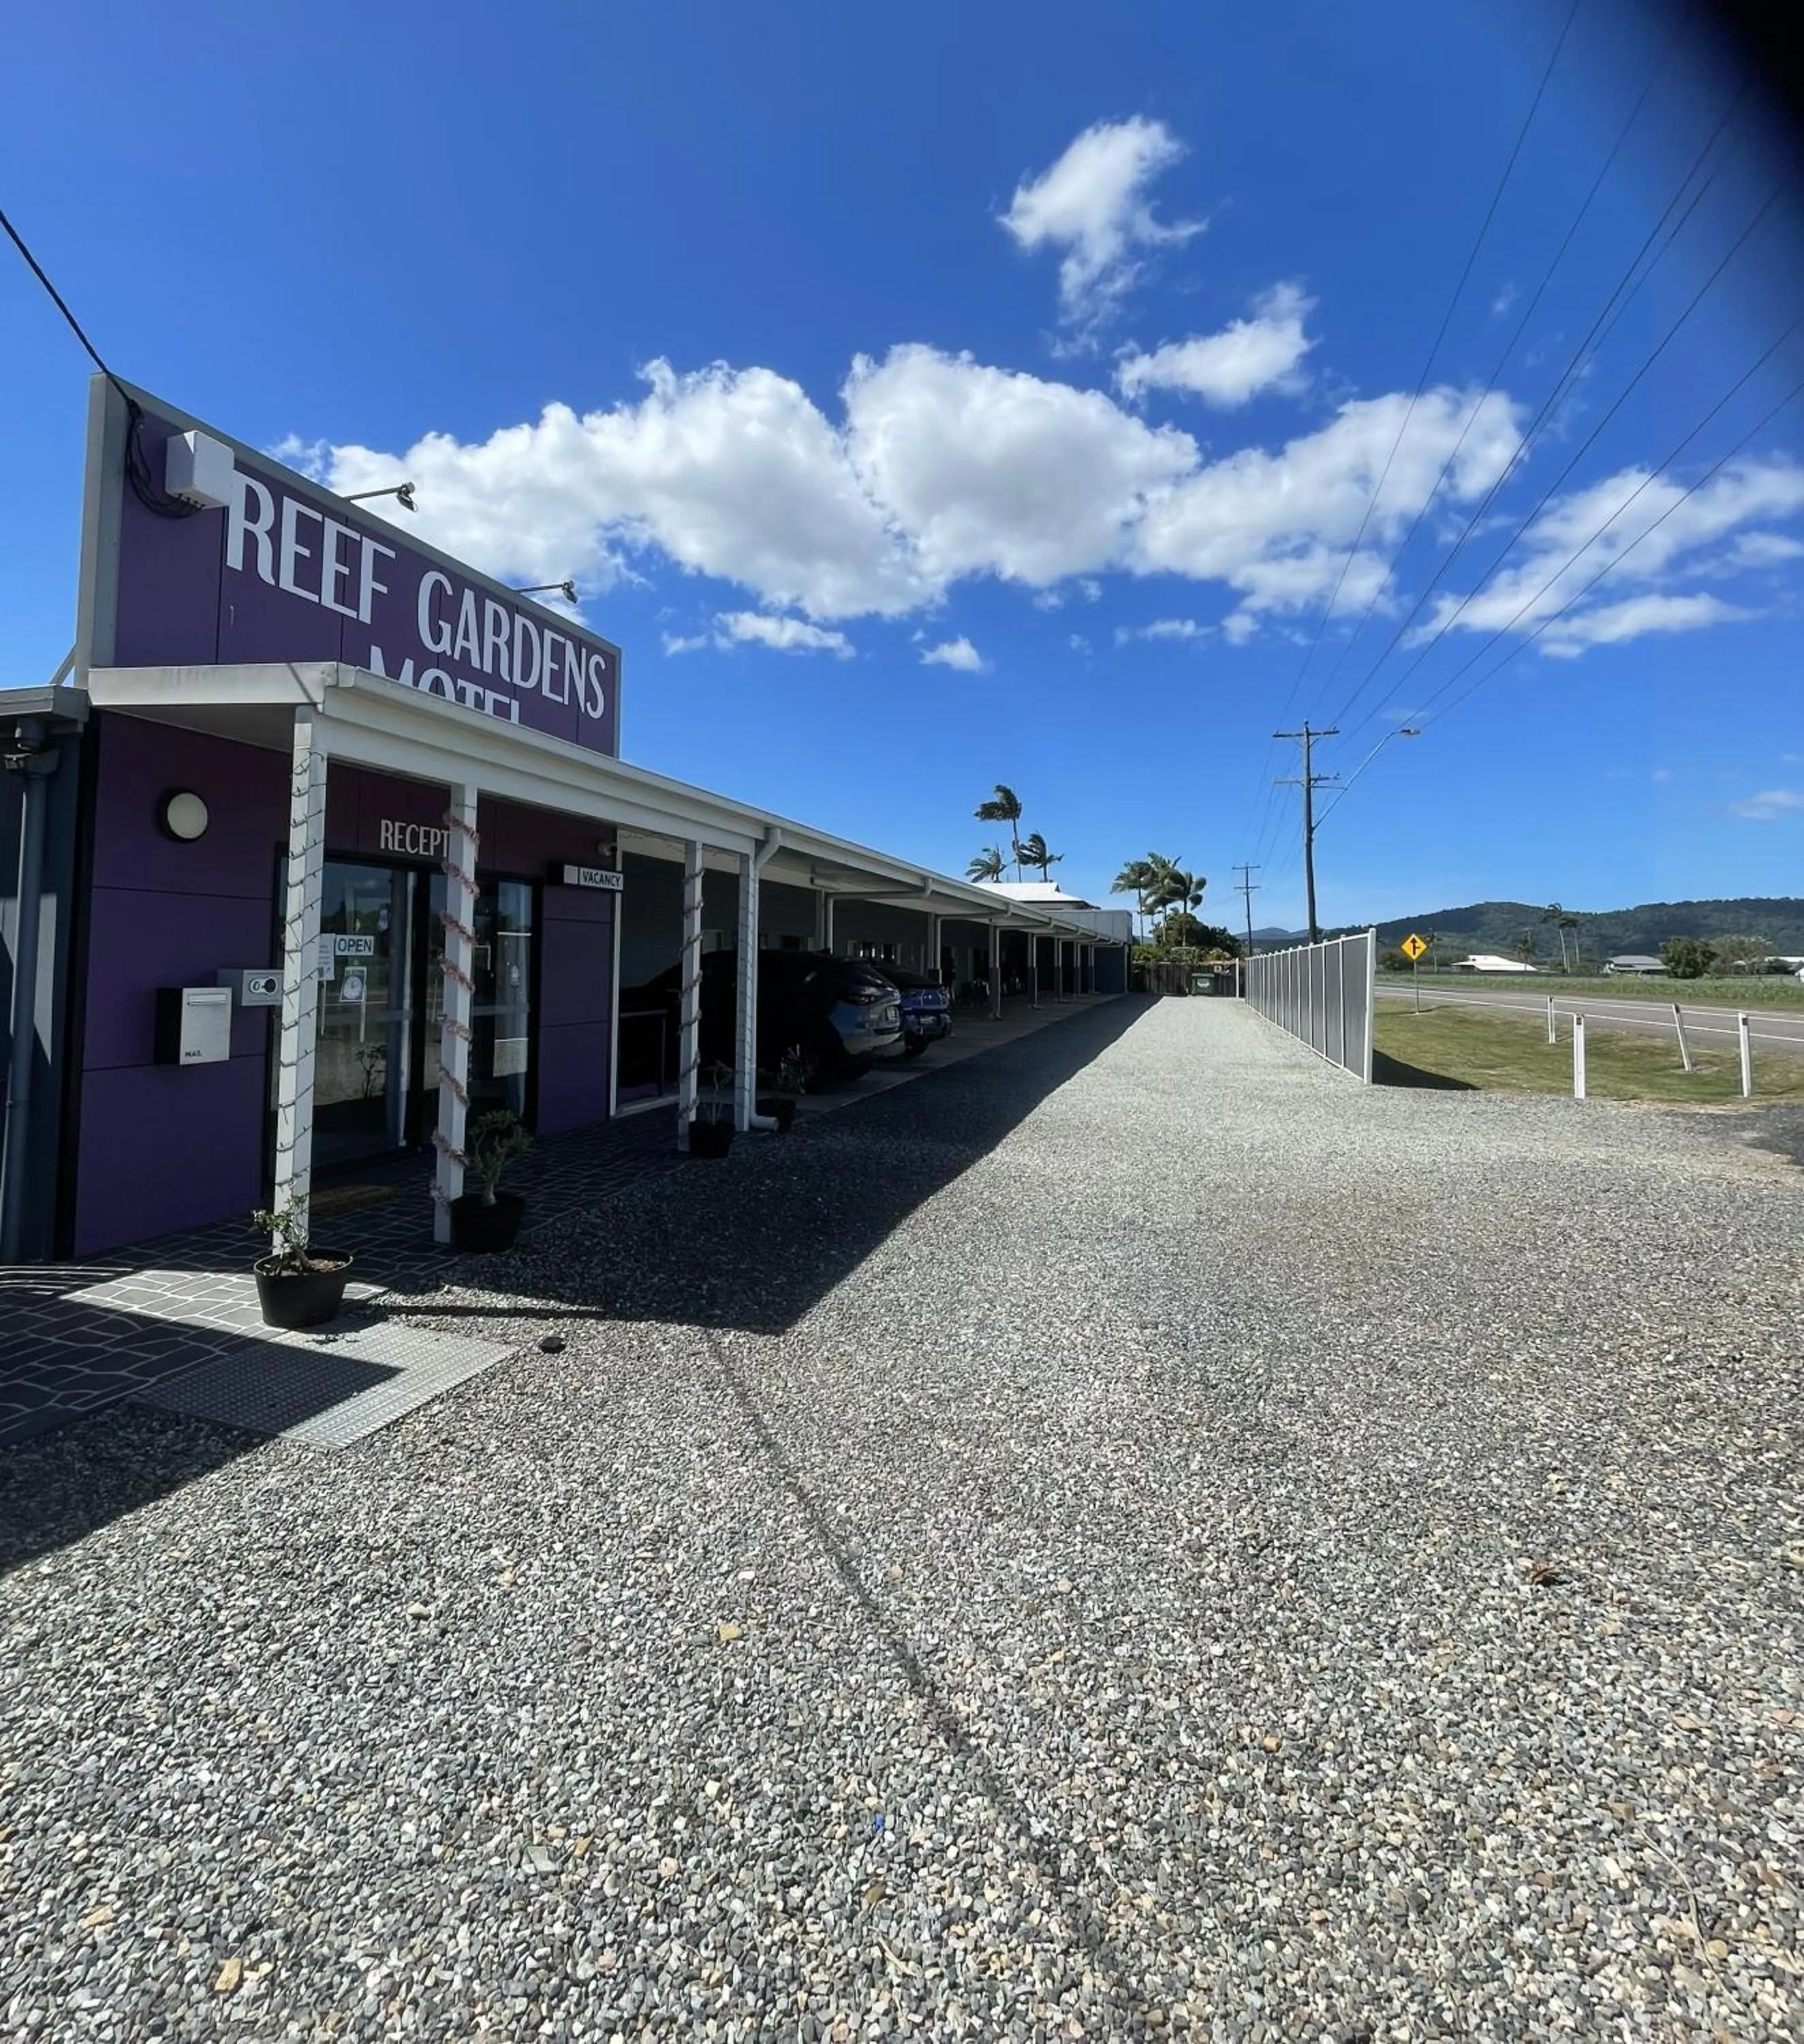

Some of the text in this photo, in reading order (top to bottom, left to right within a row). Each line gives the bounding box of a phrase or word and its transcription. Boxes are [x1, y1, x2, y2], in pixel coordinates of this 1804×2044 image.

[227, 469, 396, 625] REEF
[418, 570, 606, 719] GARDENS
[582, 871, 621, 887] VACANCY
[338, 938, 371, 952] OPEN
